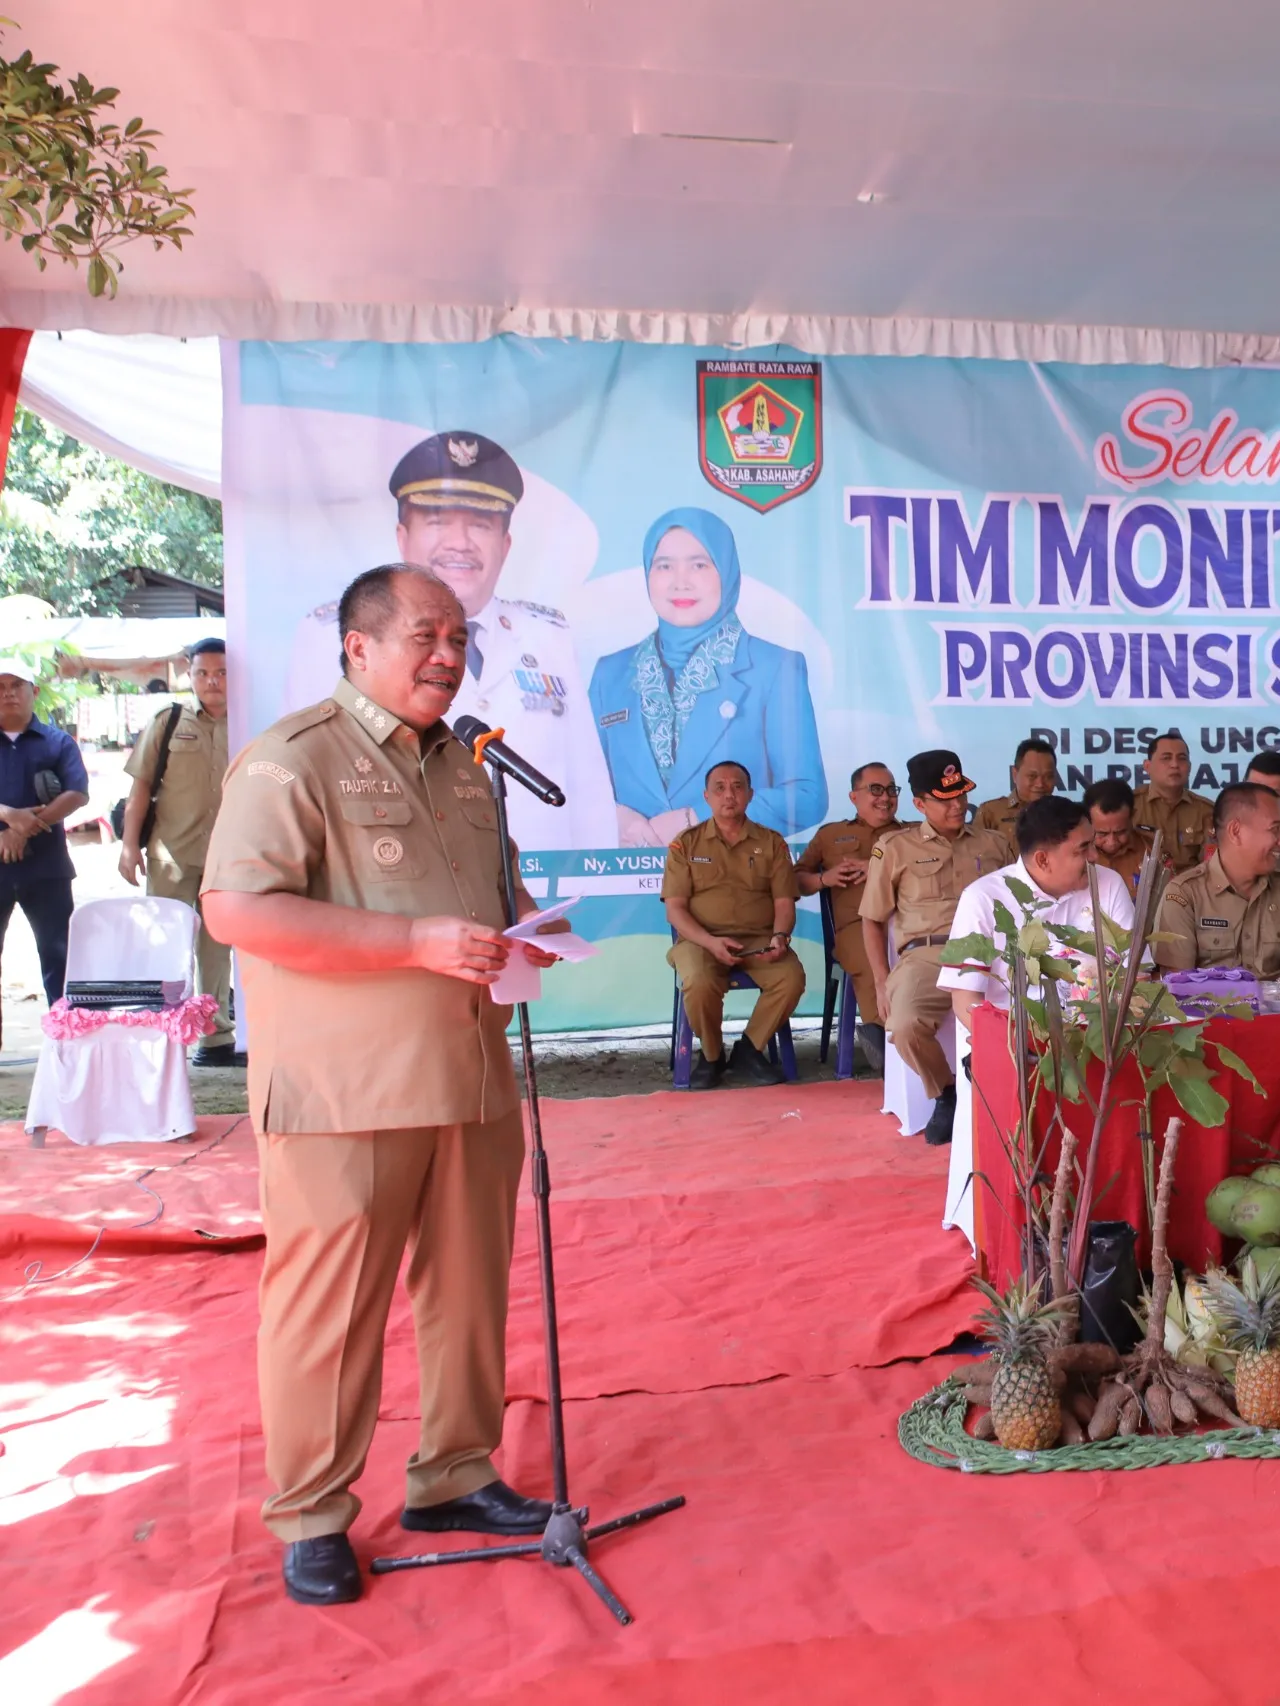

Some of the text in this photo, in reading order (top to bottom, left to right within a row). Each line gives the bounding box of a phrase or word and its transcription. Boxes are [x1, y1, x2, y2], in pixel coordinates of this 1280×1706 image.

[707, 361, 814, 374] RAMBATE RATA RAYA
[730, 468, 796, 482] KAB. ASAHAN
[850, 495, 1011, 604] TIM
[945, 629, 1252, 700] PROVINSI
[518, 857, 544, 873] .Si.
[584, 857, 611, 874] Ny.
